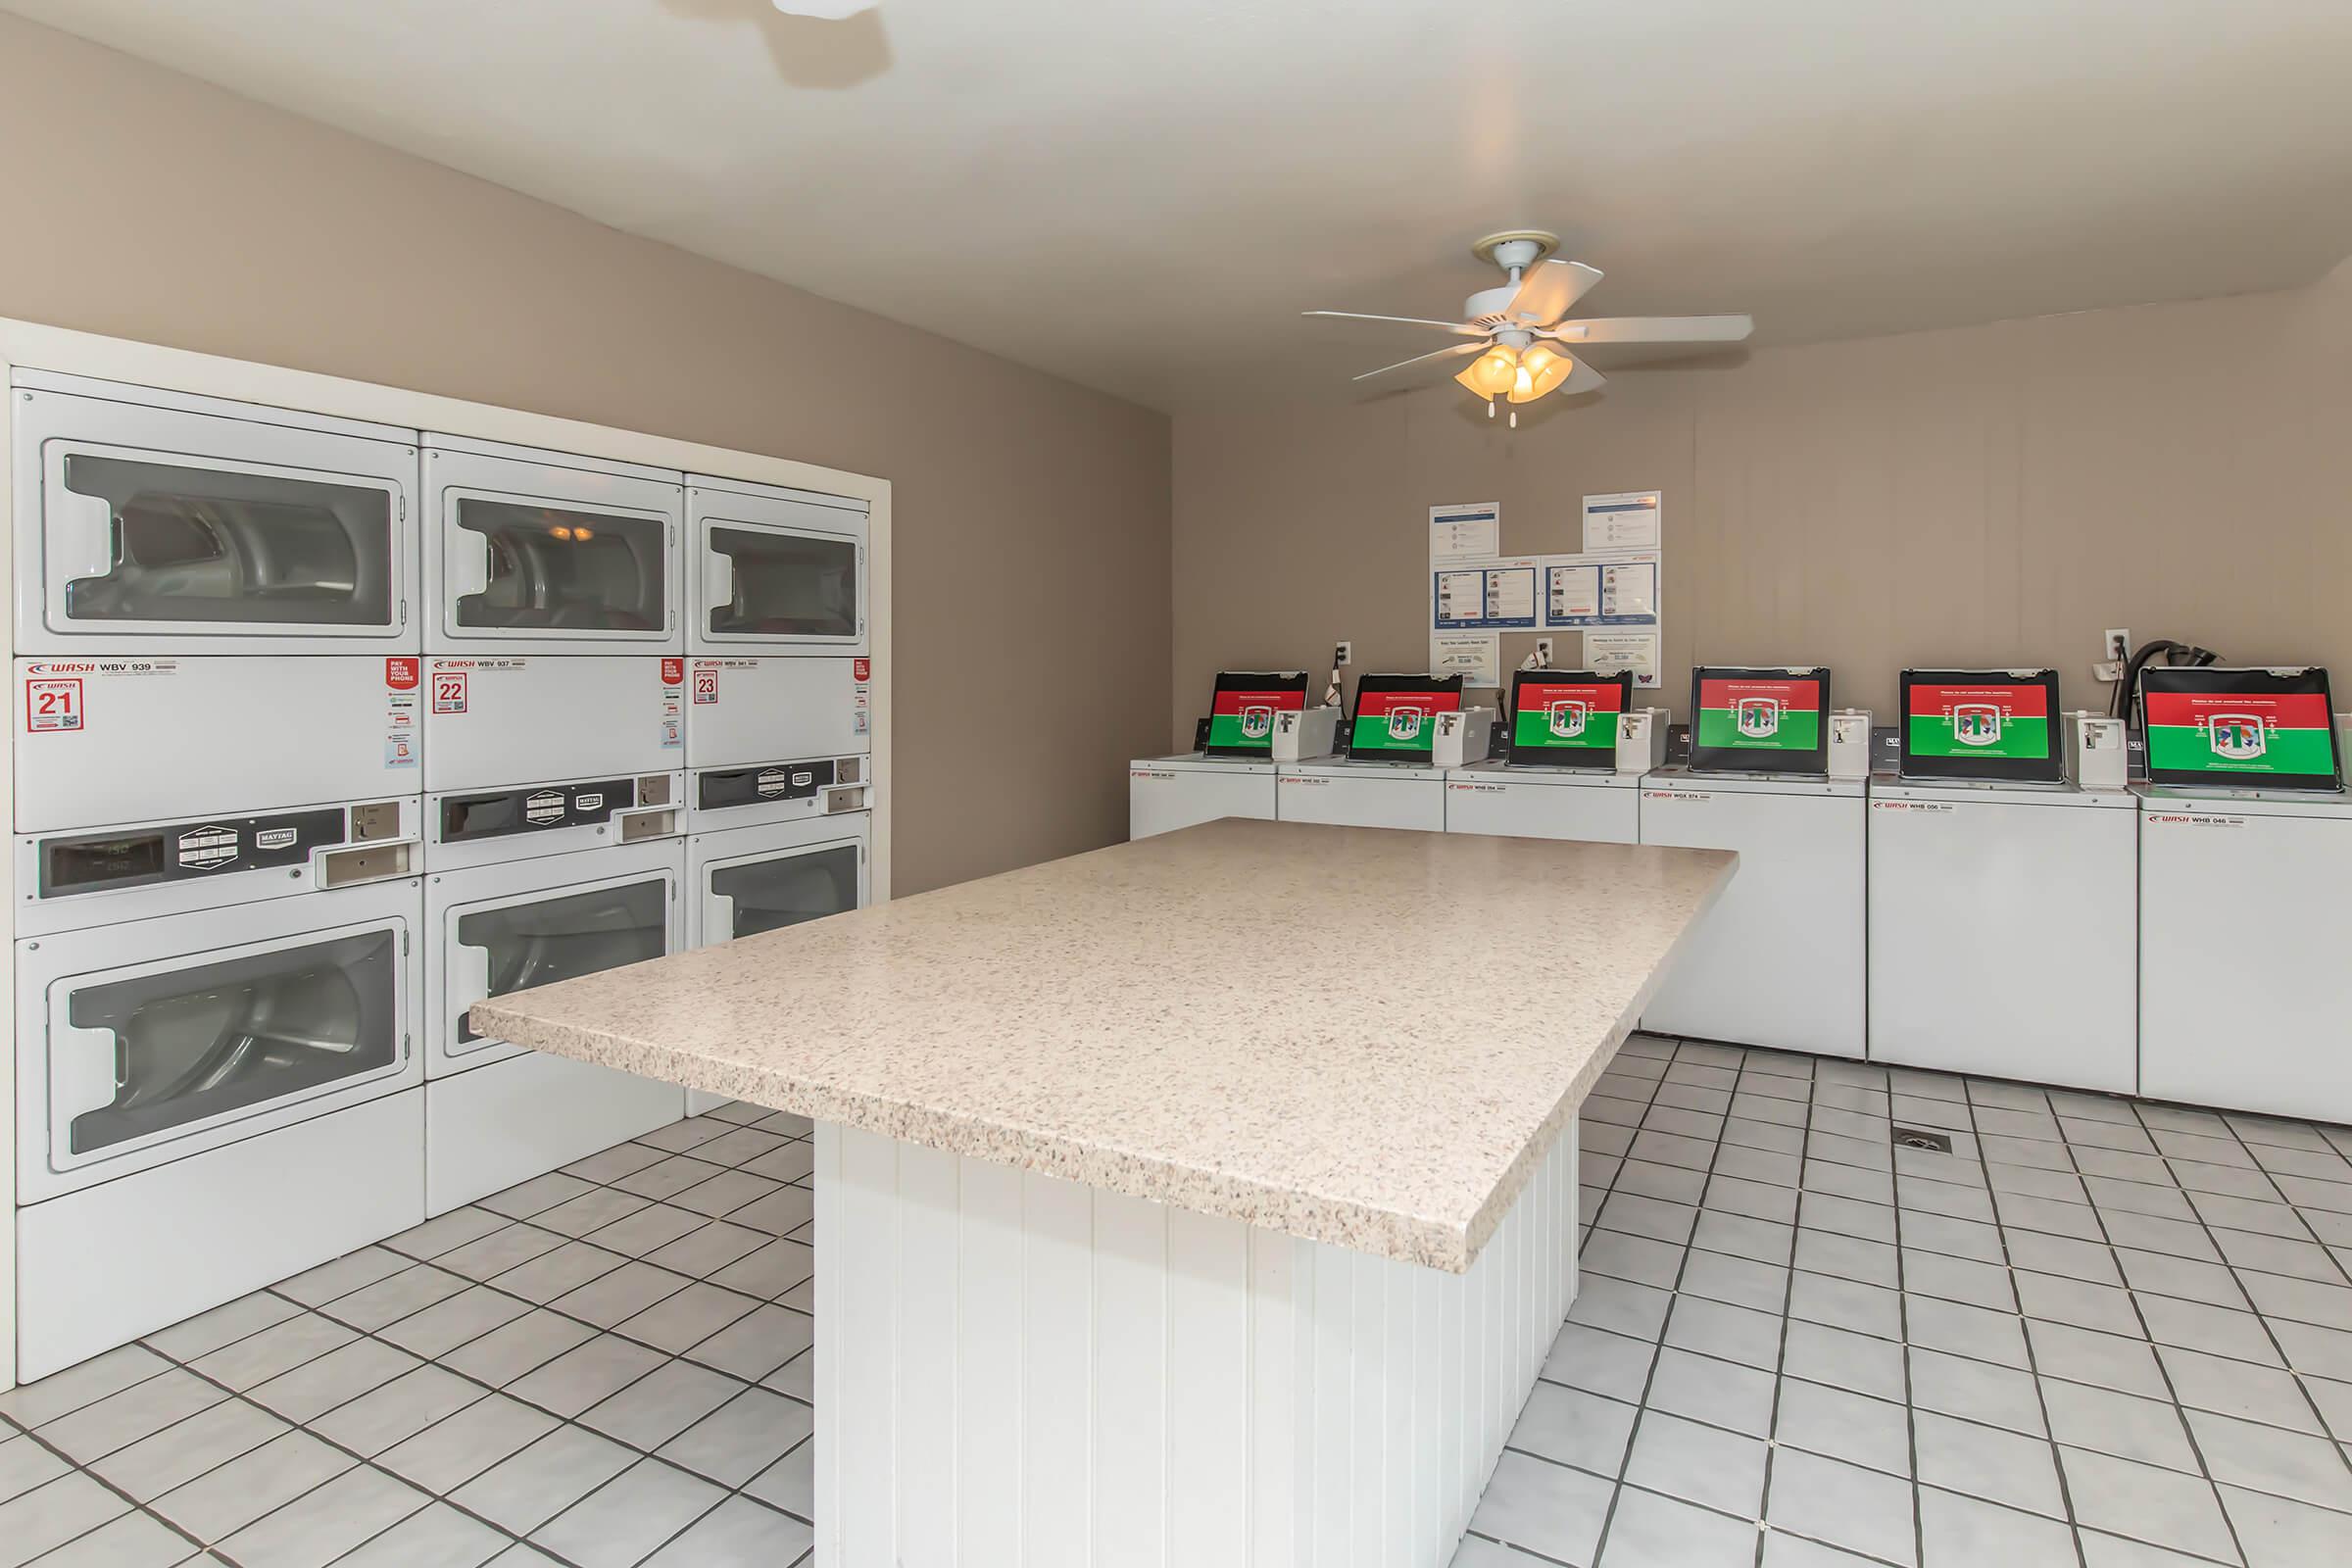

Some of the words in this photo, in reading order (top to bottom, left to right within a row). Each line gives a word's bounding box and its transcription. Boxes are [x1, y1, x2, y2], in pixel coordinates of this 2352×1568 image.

[51, 663, 95, 672] WASH
[440, 683, 462, 701] 22
[699, 678, 714, 693] 23
[38, 692, 71, 714] 21
[261, 831, 293, 841] MAYTAG
